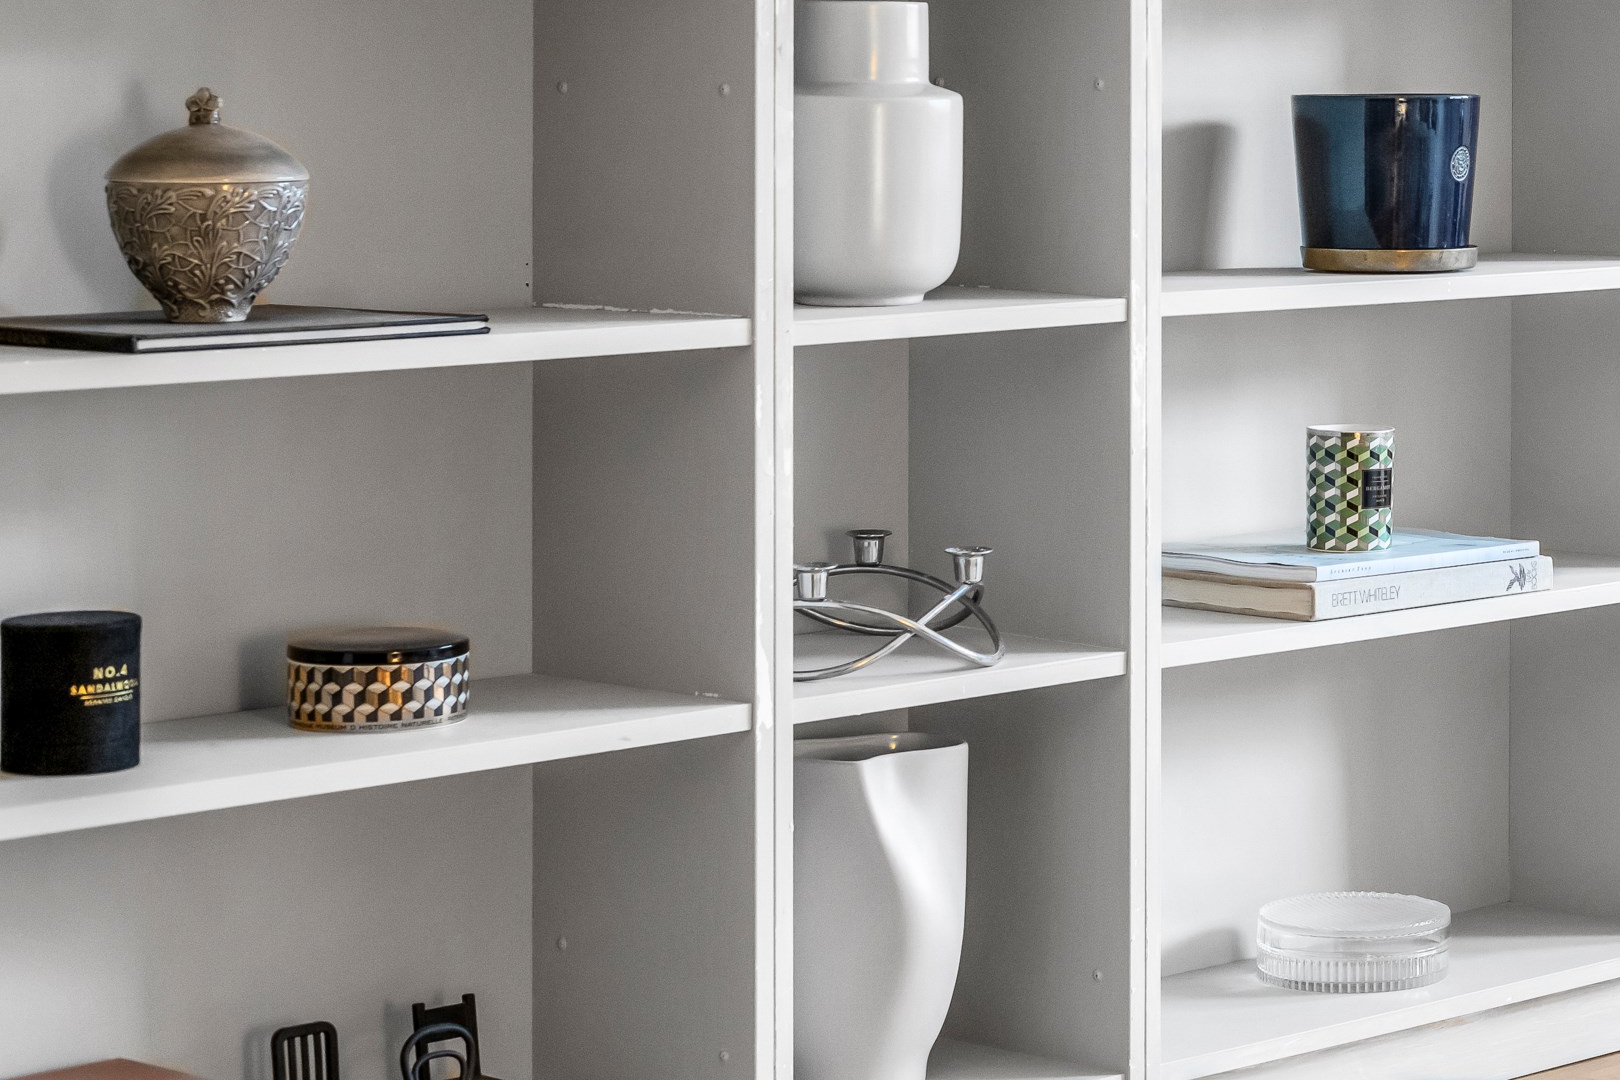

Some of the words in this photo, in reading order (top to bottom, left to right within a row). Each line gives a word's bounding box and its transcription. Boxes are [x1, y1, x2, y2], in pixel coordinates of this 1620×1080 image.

[1332, 590, 1358, 607] BRETT
[1359, 584, 1401, 604] WHITELEY
[93, 663, 128, 680] NO.4
